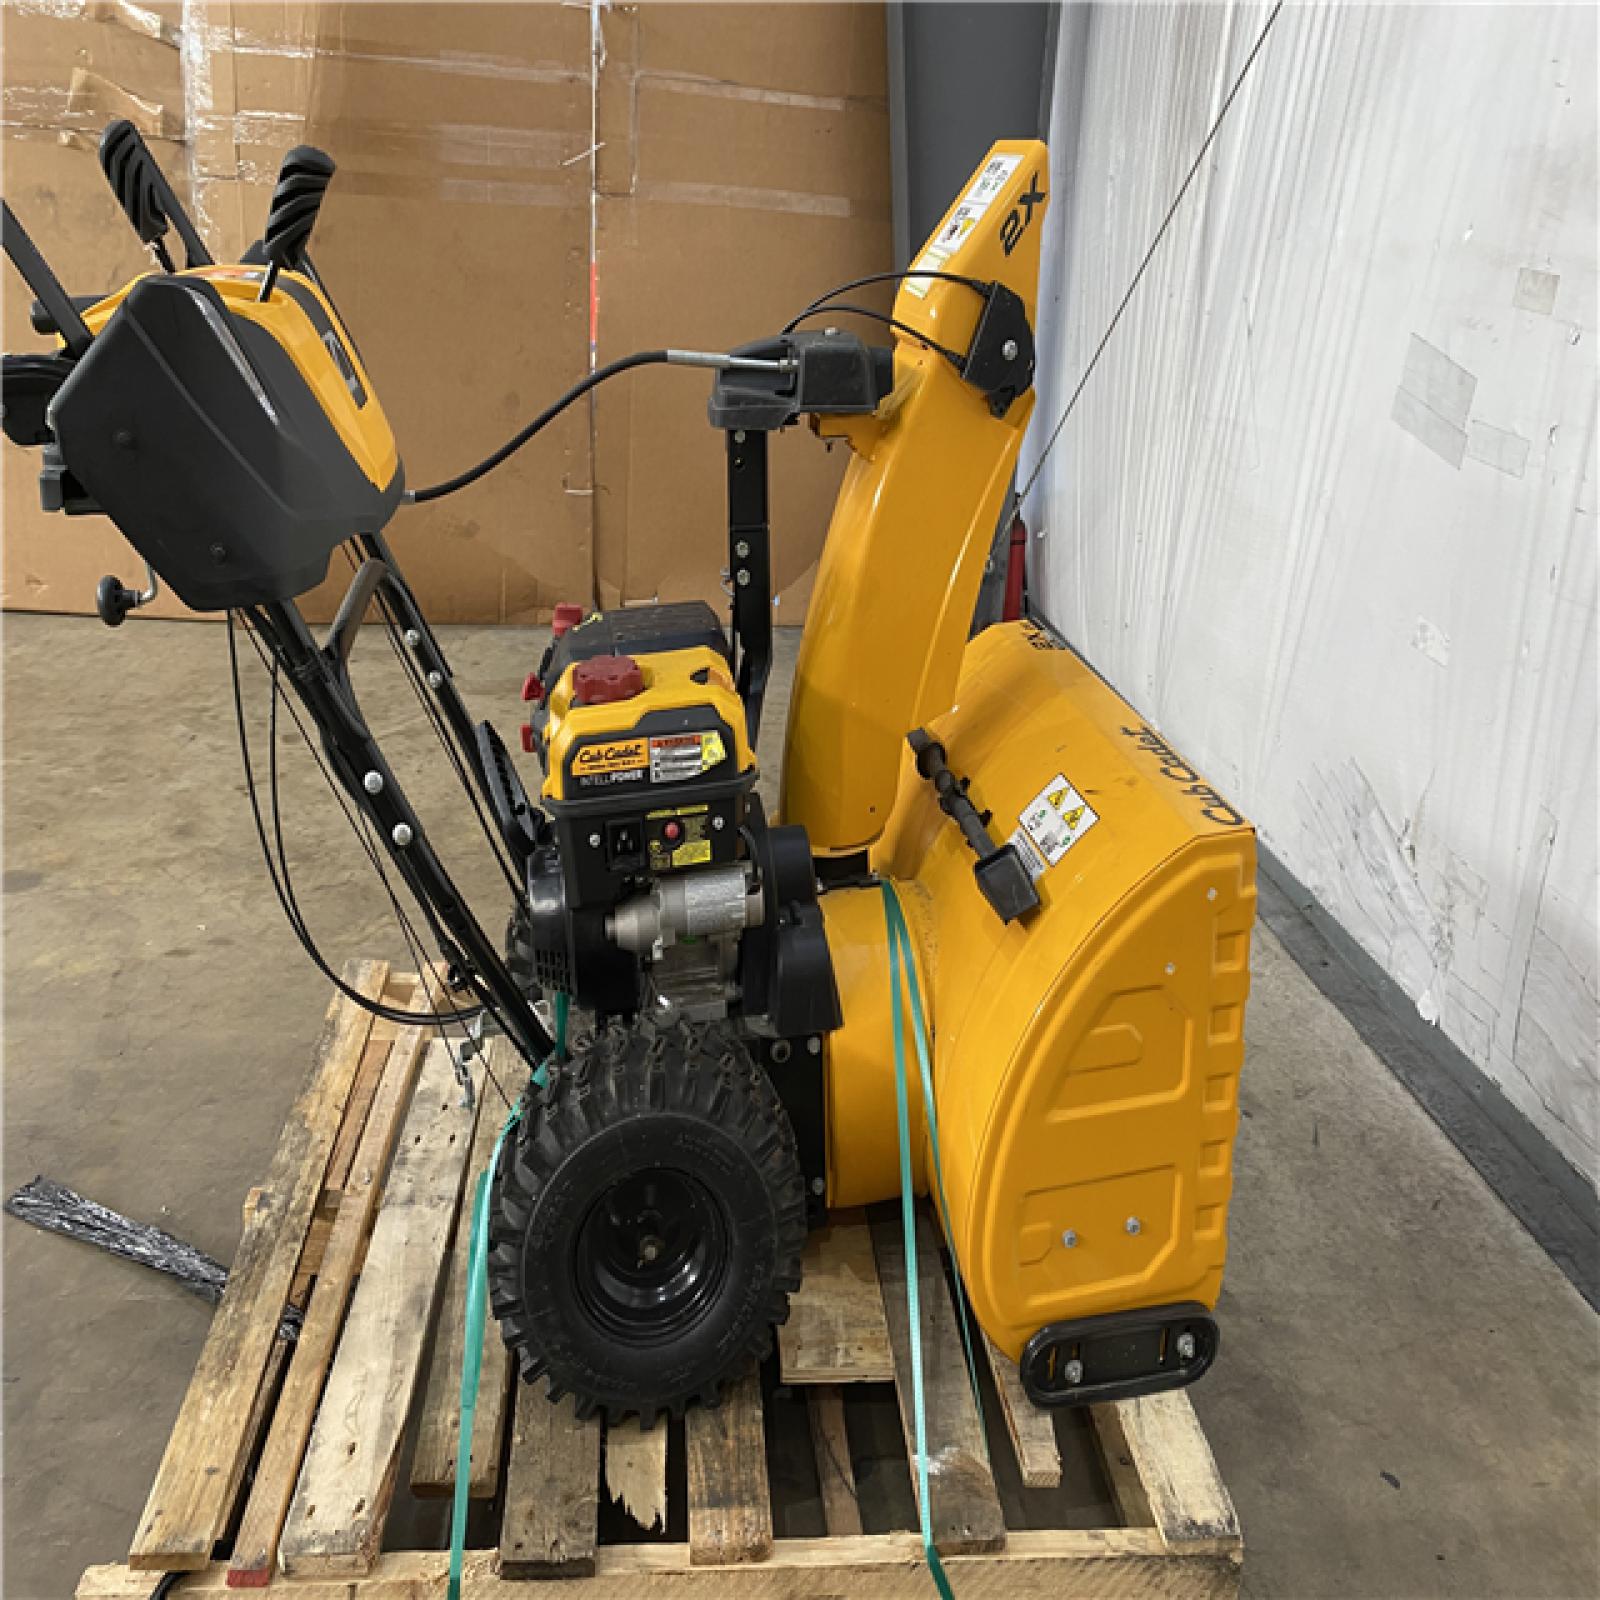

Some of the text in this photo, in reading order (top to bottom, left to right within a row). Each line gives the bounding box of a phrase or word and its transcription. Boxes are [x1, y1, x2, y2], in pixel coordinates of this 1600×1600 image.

[579, 744, 642, 762] Cub Cadet
[1120, 724, 1244, 825] Cub Cadet
